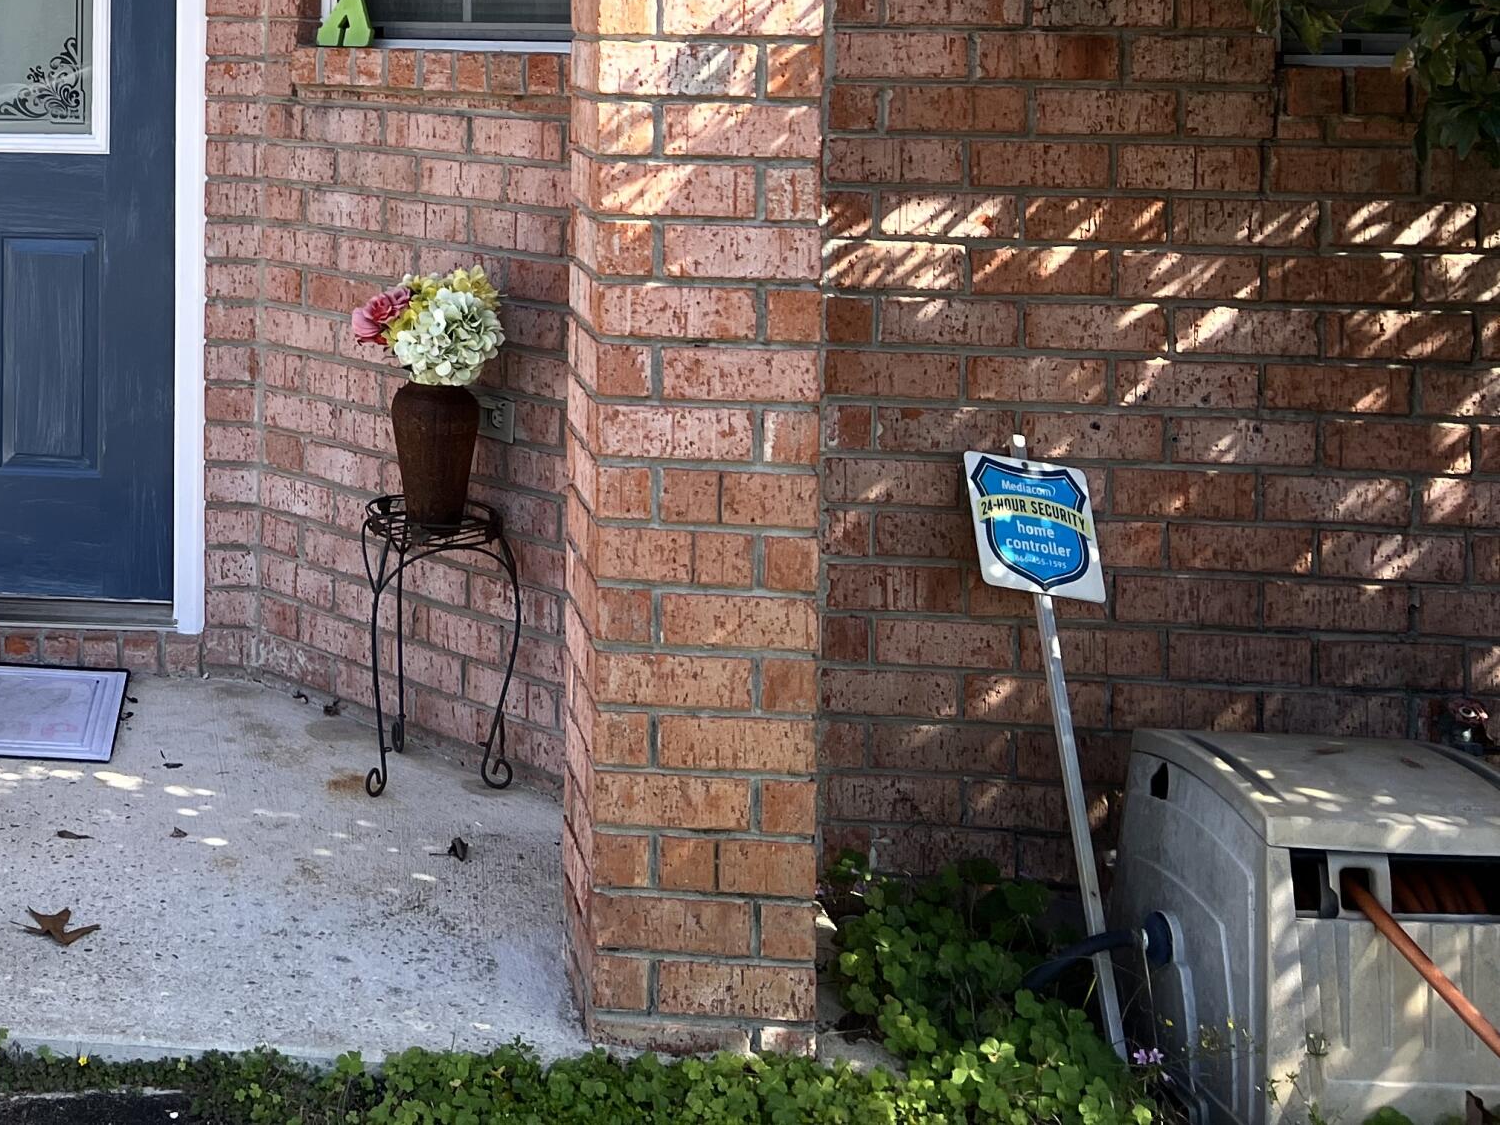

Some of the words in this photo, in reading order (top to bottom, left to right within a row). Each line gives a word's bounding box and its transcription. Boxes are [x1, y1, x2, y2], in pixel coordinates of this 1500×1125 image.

[1001, 479, 1052, 497] Mediacom
[980, 497, 1027, 516] 24-HOUR
[1030, 500, 1085, 531] SECURITY
[1016, 519, 1055, 539] home
[1005, 537, 1072, 558] controller
